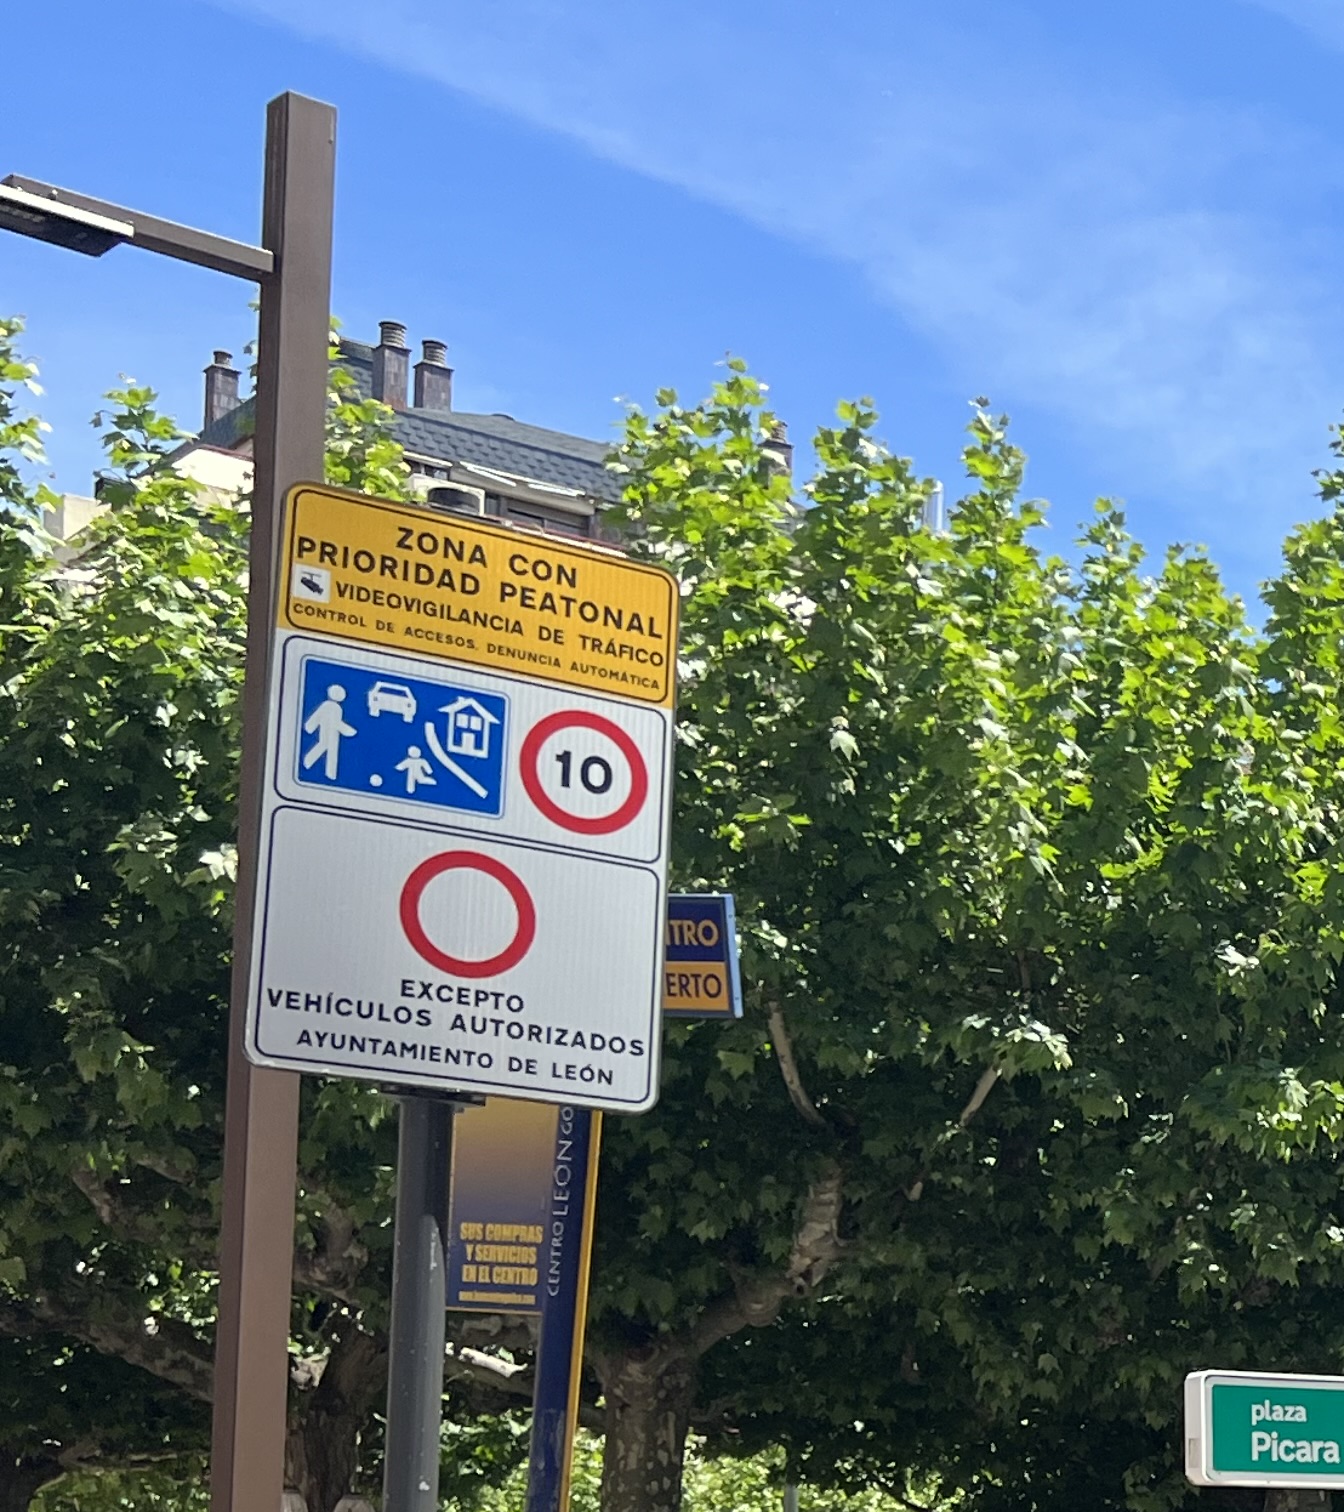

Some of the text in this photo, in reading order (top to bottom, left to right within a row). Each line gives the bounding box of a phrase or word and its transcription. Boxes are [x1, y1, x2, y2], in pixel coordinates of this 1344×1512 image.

[396, 526, 578, 588] ZONA CON
[297, 536, 664, 639] PRIORIDAD PEATONAL
[292, 602, 368, 629] CONTROL
[375, 619, 395, 634] DE
[487, 642, 562, 668] DENUNCIA
[570, 659, 661, 690] AUTOMÁTICA
[335, 580, 664, 668] VIDEOVIGILANCIA DE TRÁFICO
[555, 749, 612, 795] 10
[400, 979, 525, 1014] EXCEPTO
[267, 988, 646, 1057] VEHÍCULOS AUTORIZADOS
[296, 1029, 614, 1086] AYUNTAMIENTO DE LEÓN
[475, 1244, 537, 1265] SERVICIOS
[485, 1223, 544, 1244] COMPRAS
[492, 1266, 538, 1286] CENTRO
[1251, 1400, 1307, 1426] plaza
[1251, 1432, 1340, 1464] Picara
